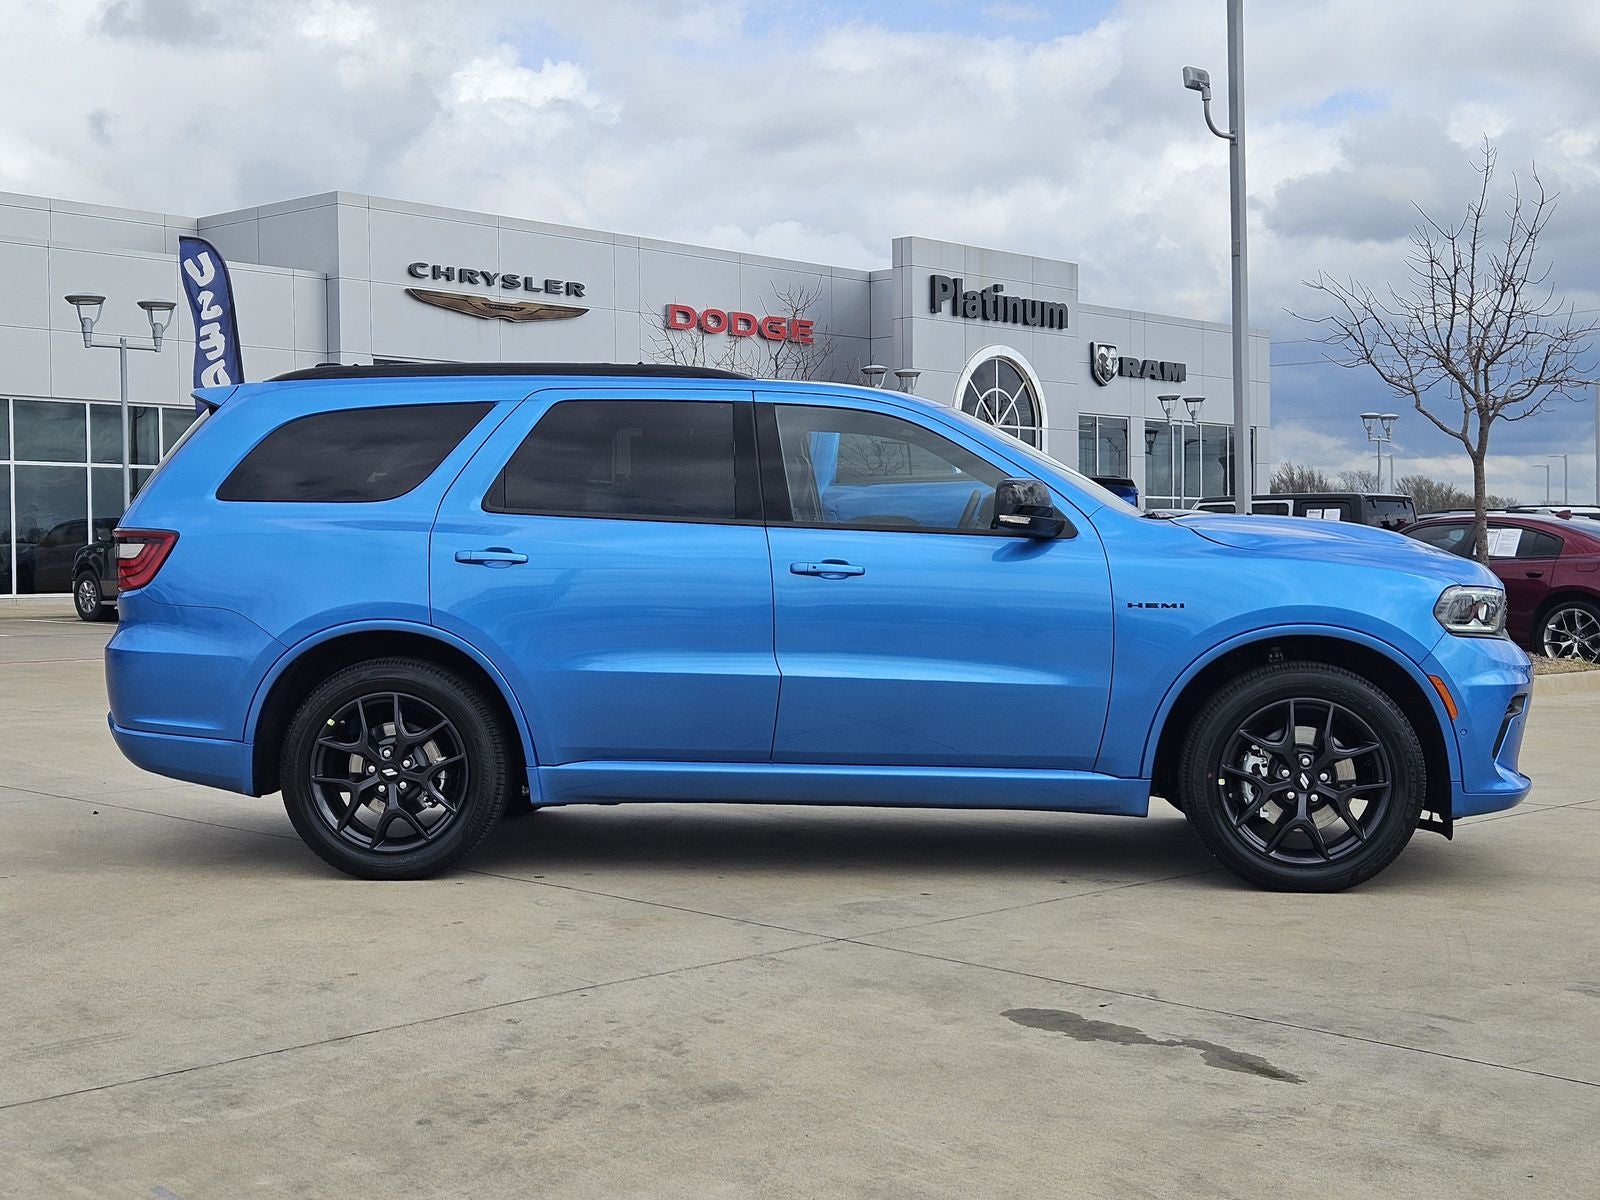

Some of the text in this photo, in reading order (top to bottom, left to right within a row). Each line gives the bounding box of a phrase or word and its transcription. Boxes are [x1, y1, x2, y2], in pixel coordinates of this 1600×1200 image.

[407, 262, 586, 297] CHRYSLER
[930, 274, 1069, 329] Platinum
[665, 303, 815, 344] DODGE
[1118, 356, 1187, 382] RAM
